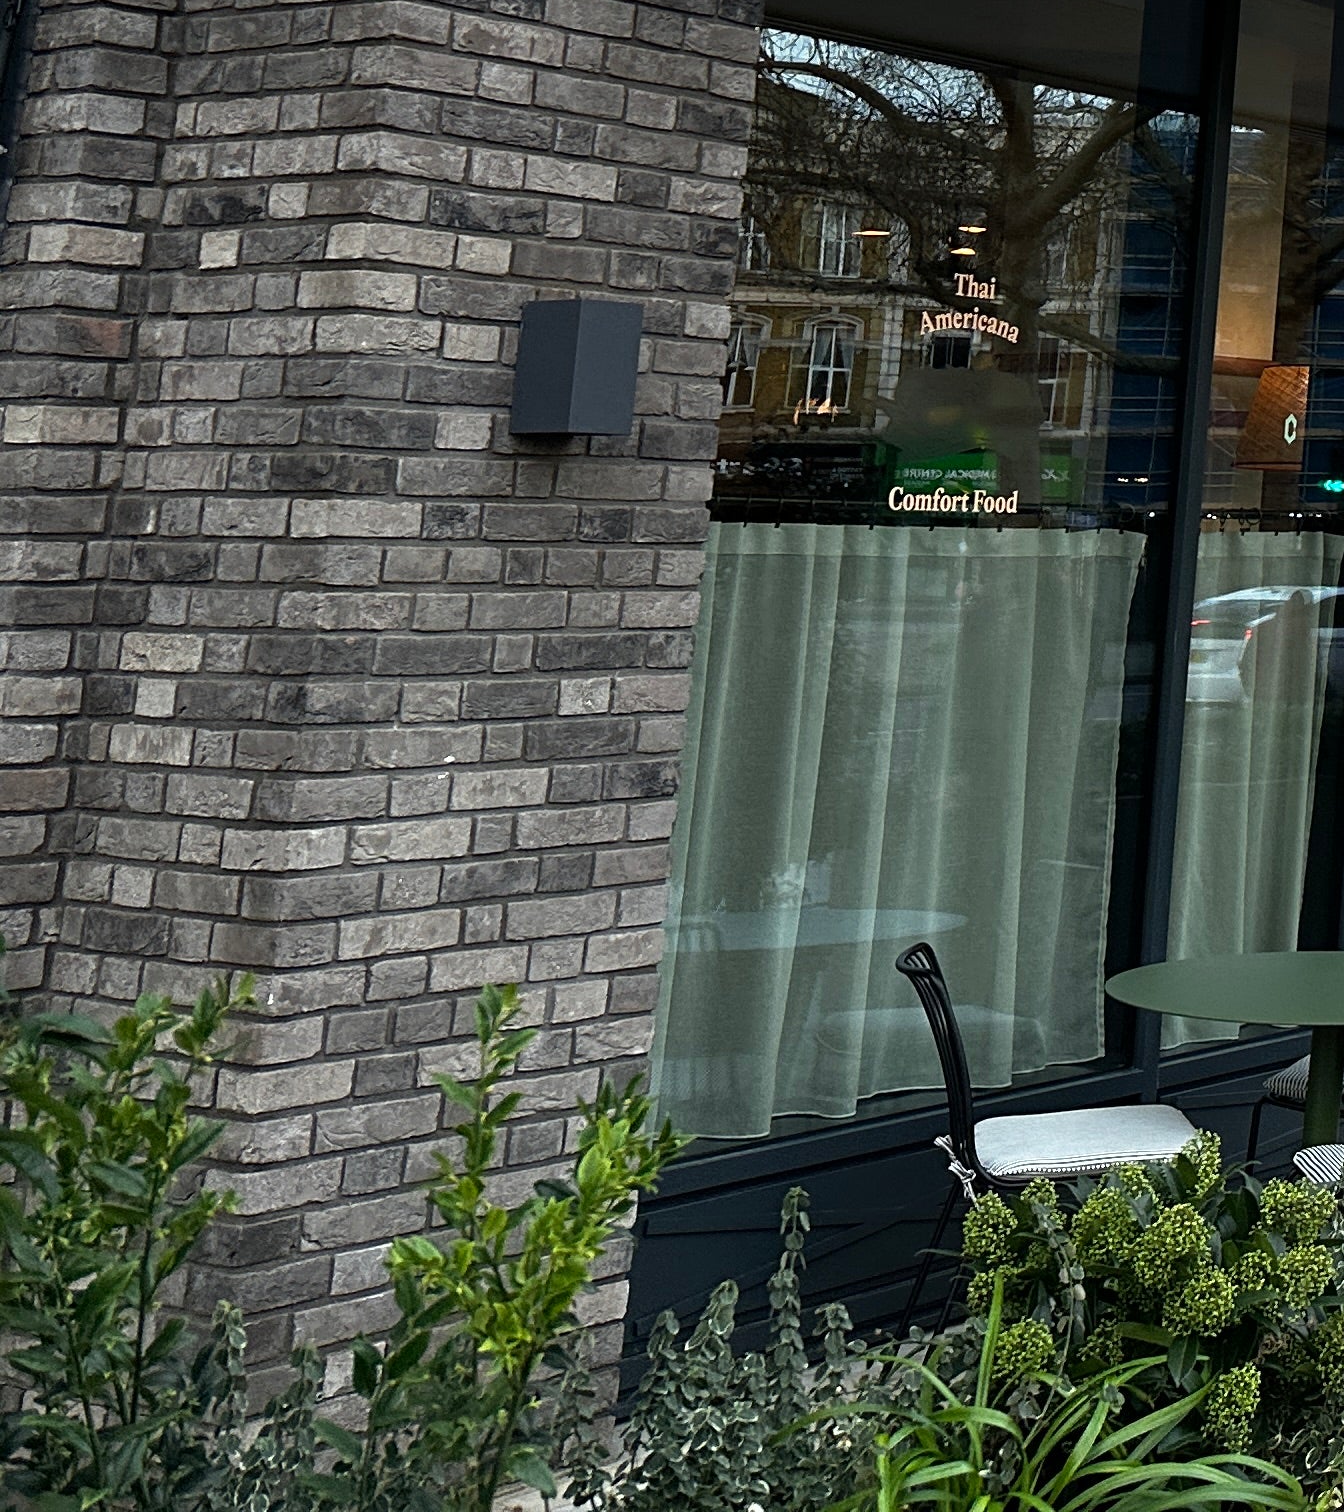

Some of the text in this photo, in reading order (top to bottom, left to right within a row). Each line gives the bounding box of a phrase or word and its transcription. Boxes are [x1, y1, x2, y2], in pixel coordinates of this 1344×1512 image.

[954, 273, 996, 299] Thai
[920, 307, 1019, 343] Americana
[888, 486, 1019, 514] Comfort Food
